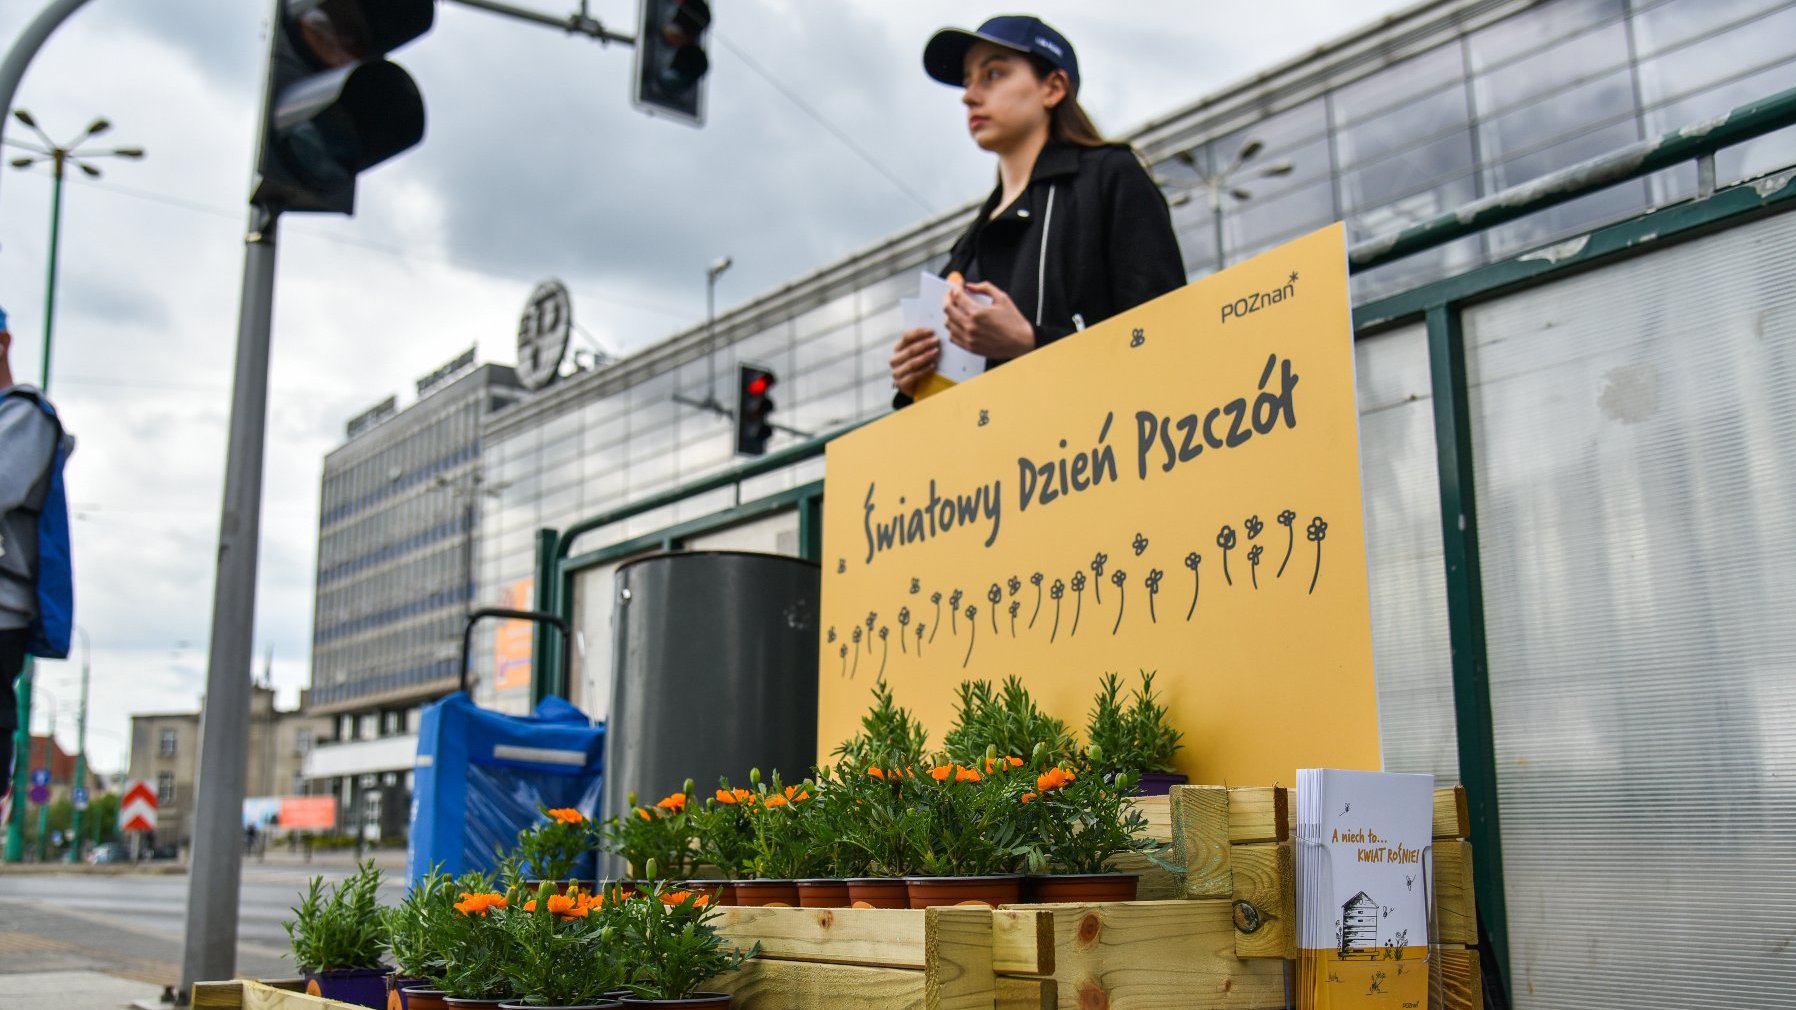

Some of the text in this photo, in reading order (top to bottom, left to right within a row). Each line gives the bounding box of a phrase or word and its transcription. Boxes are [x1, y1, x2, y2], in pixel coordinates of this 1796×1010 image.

[863, 353, 1299, 565] Światowy Dzień Pszczół
[1331, 827, 1388, 844] A niech to...
[1357, 847, 1387, 863] KWIAT
